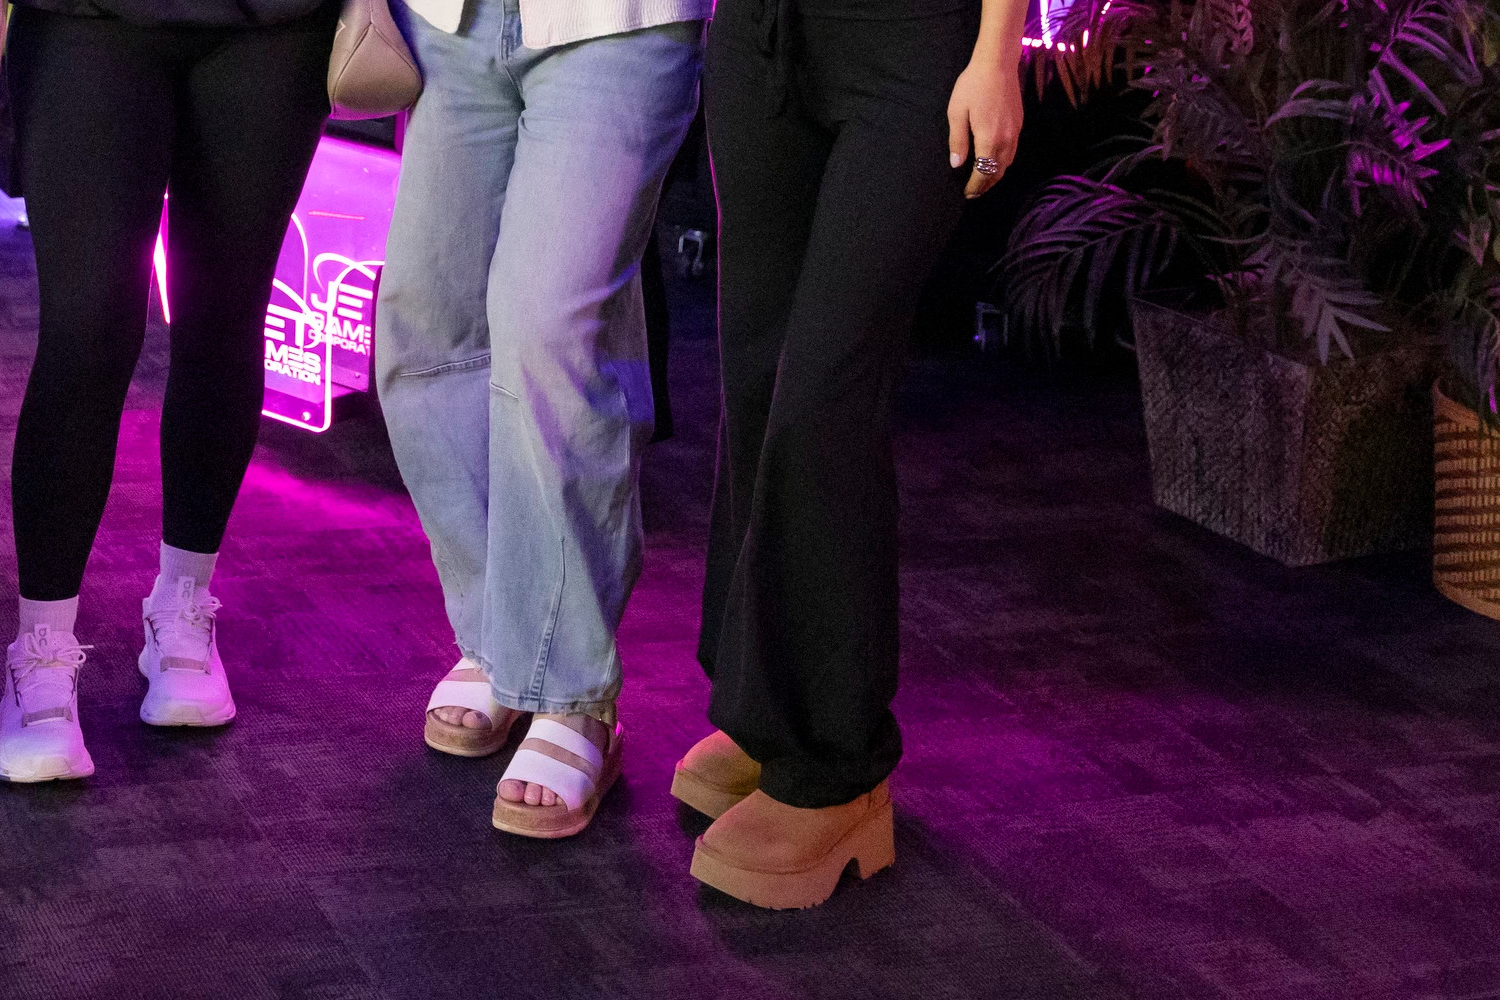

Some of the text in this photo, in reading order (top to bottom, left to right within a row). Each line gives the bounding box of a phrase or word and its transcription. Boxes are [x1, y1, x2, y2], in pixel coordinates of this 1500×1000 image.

[310, 281, 373, 321] JE
[264, 303, 312, 347] ET
[264, 358, 321, 386] ORATION
[265, 340, 321, 374] MES
